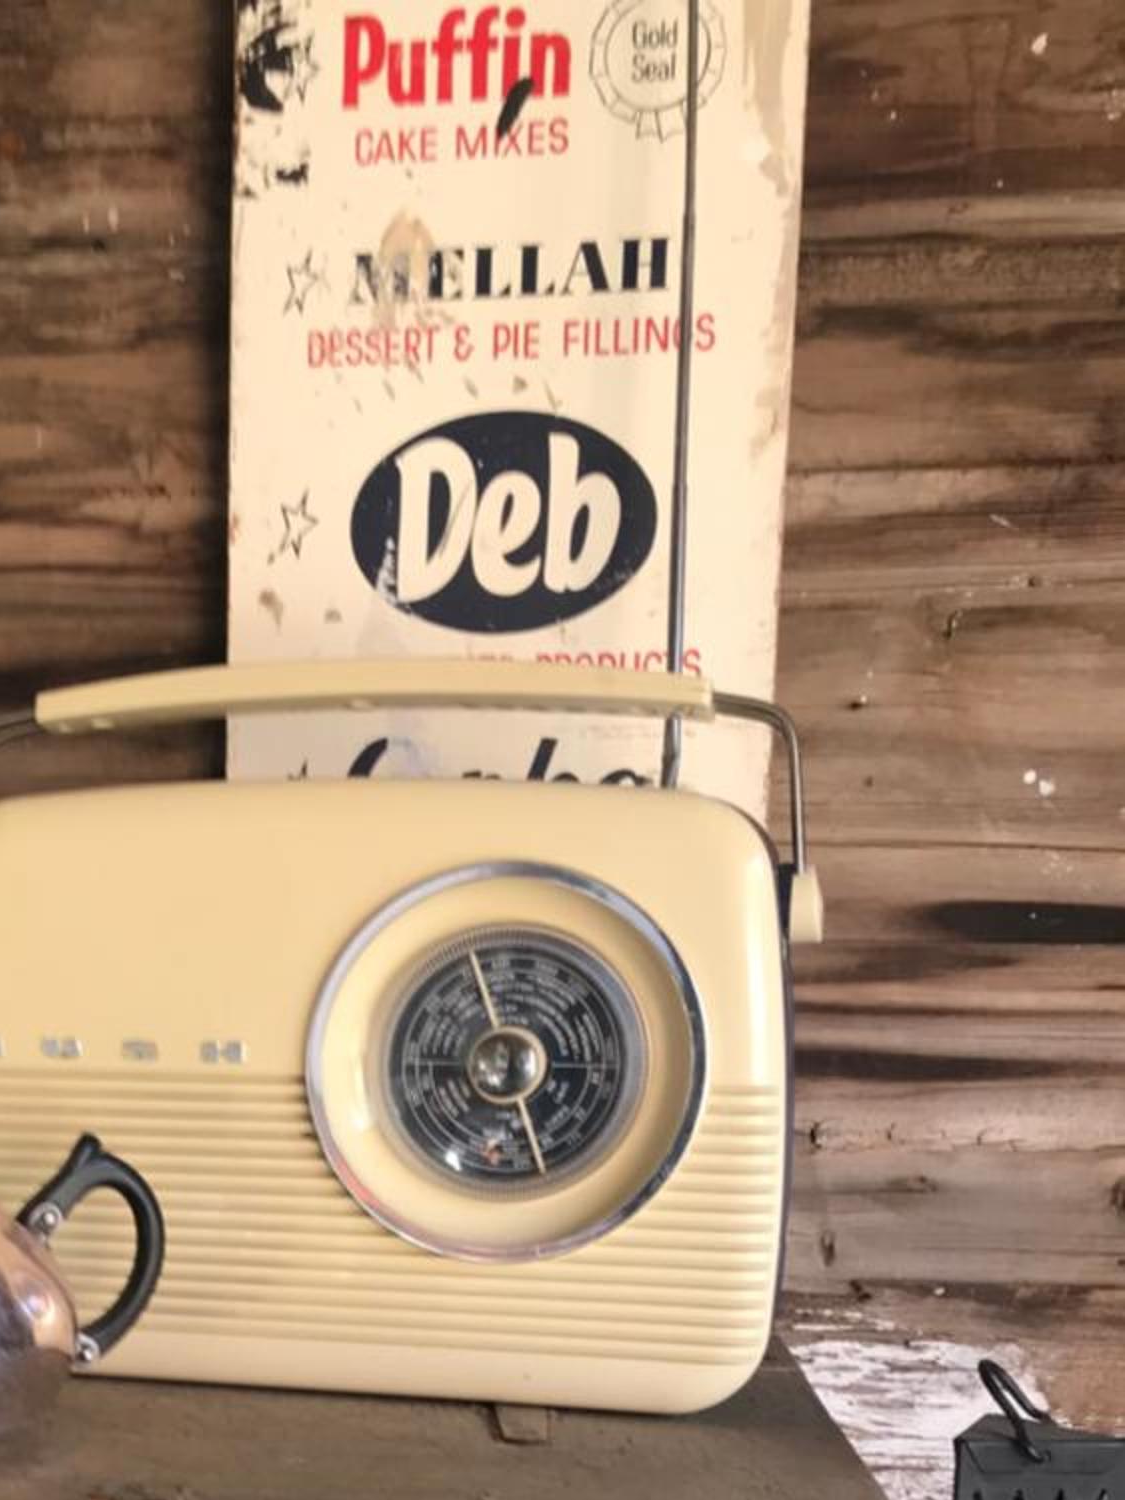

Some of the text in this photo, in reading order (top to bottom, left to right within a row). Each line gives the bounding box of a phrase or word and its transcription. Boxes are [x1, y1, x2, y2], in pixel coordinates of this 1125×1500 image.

[343, 7, 572, 109] Puffin
[632, 19, 678, 50] Gold
[632, 52, 677, 83] Seal
[354, 117, 569, 166] CAKE MIXES
[349, 237, 671, 304] MELLAH
[307, 323, 441, 368] DESSERT
[453, 323, 474, 362] &
[492, 320, 540, 360] PIE
[394, 431, 622, 603] Deb
